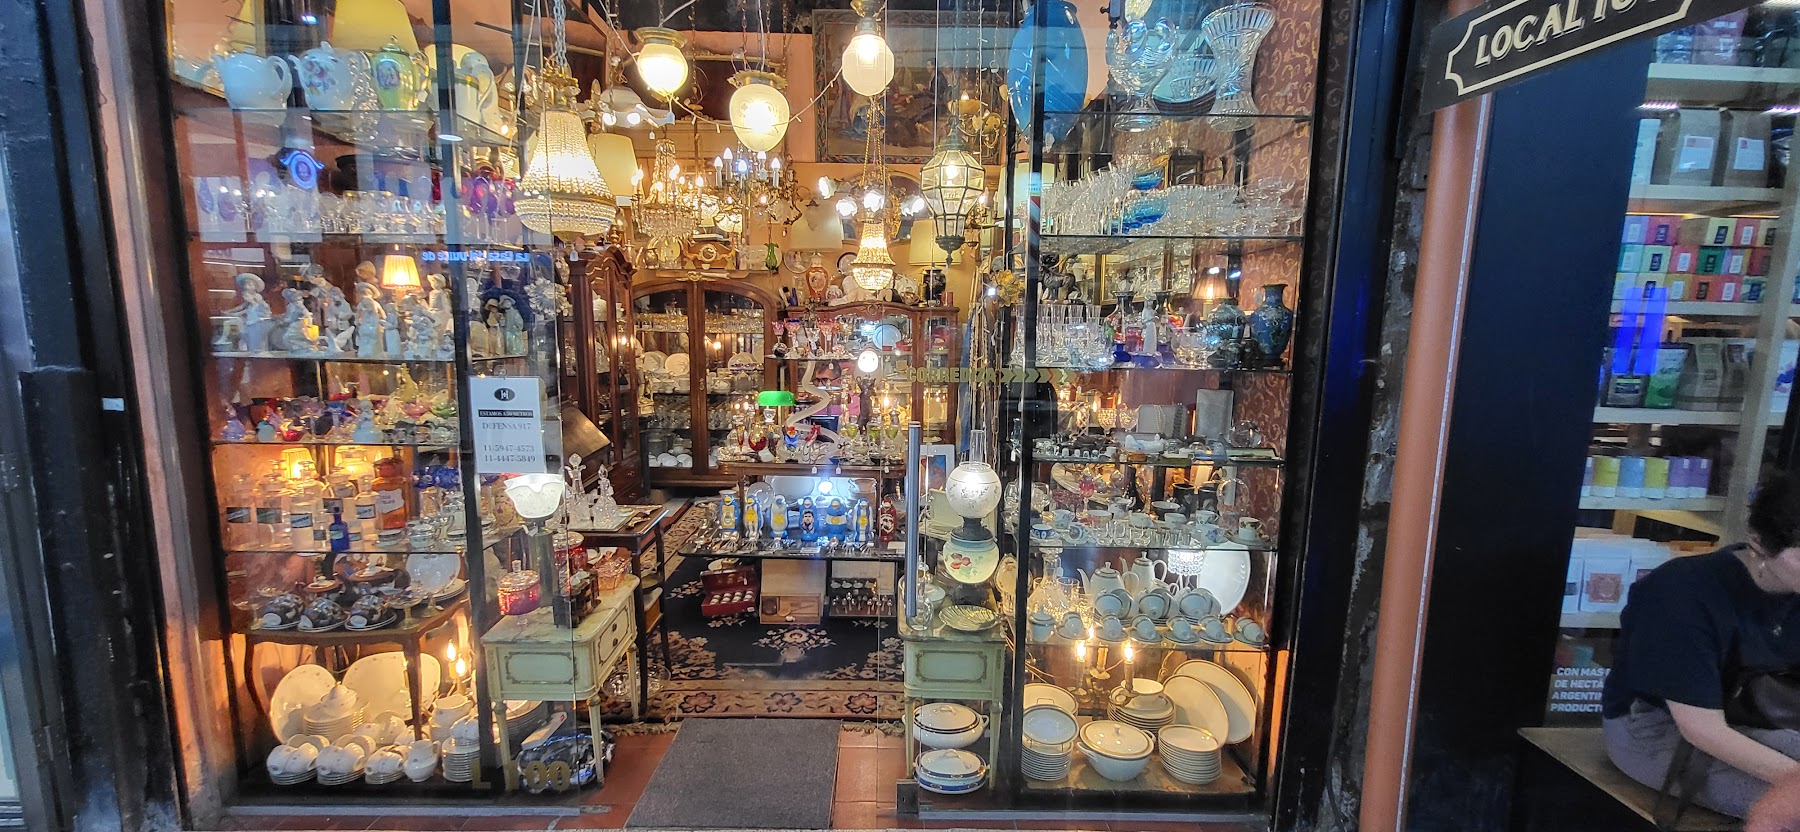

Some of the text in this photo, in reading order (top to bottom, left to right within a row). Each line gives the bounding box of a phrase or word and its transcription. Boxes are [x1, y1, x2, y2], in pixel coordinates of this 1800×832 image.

[1475, 0, 1584, 67] LOCAL
[906, 367, 996, 383] CORREDIZA
[482, 422, 517, 430] DEFENSA
[1556, 667, 1580, 676] CON
[1554, 679, 1568, 688] DE
